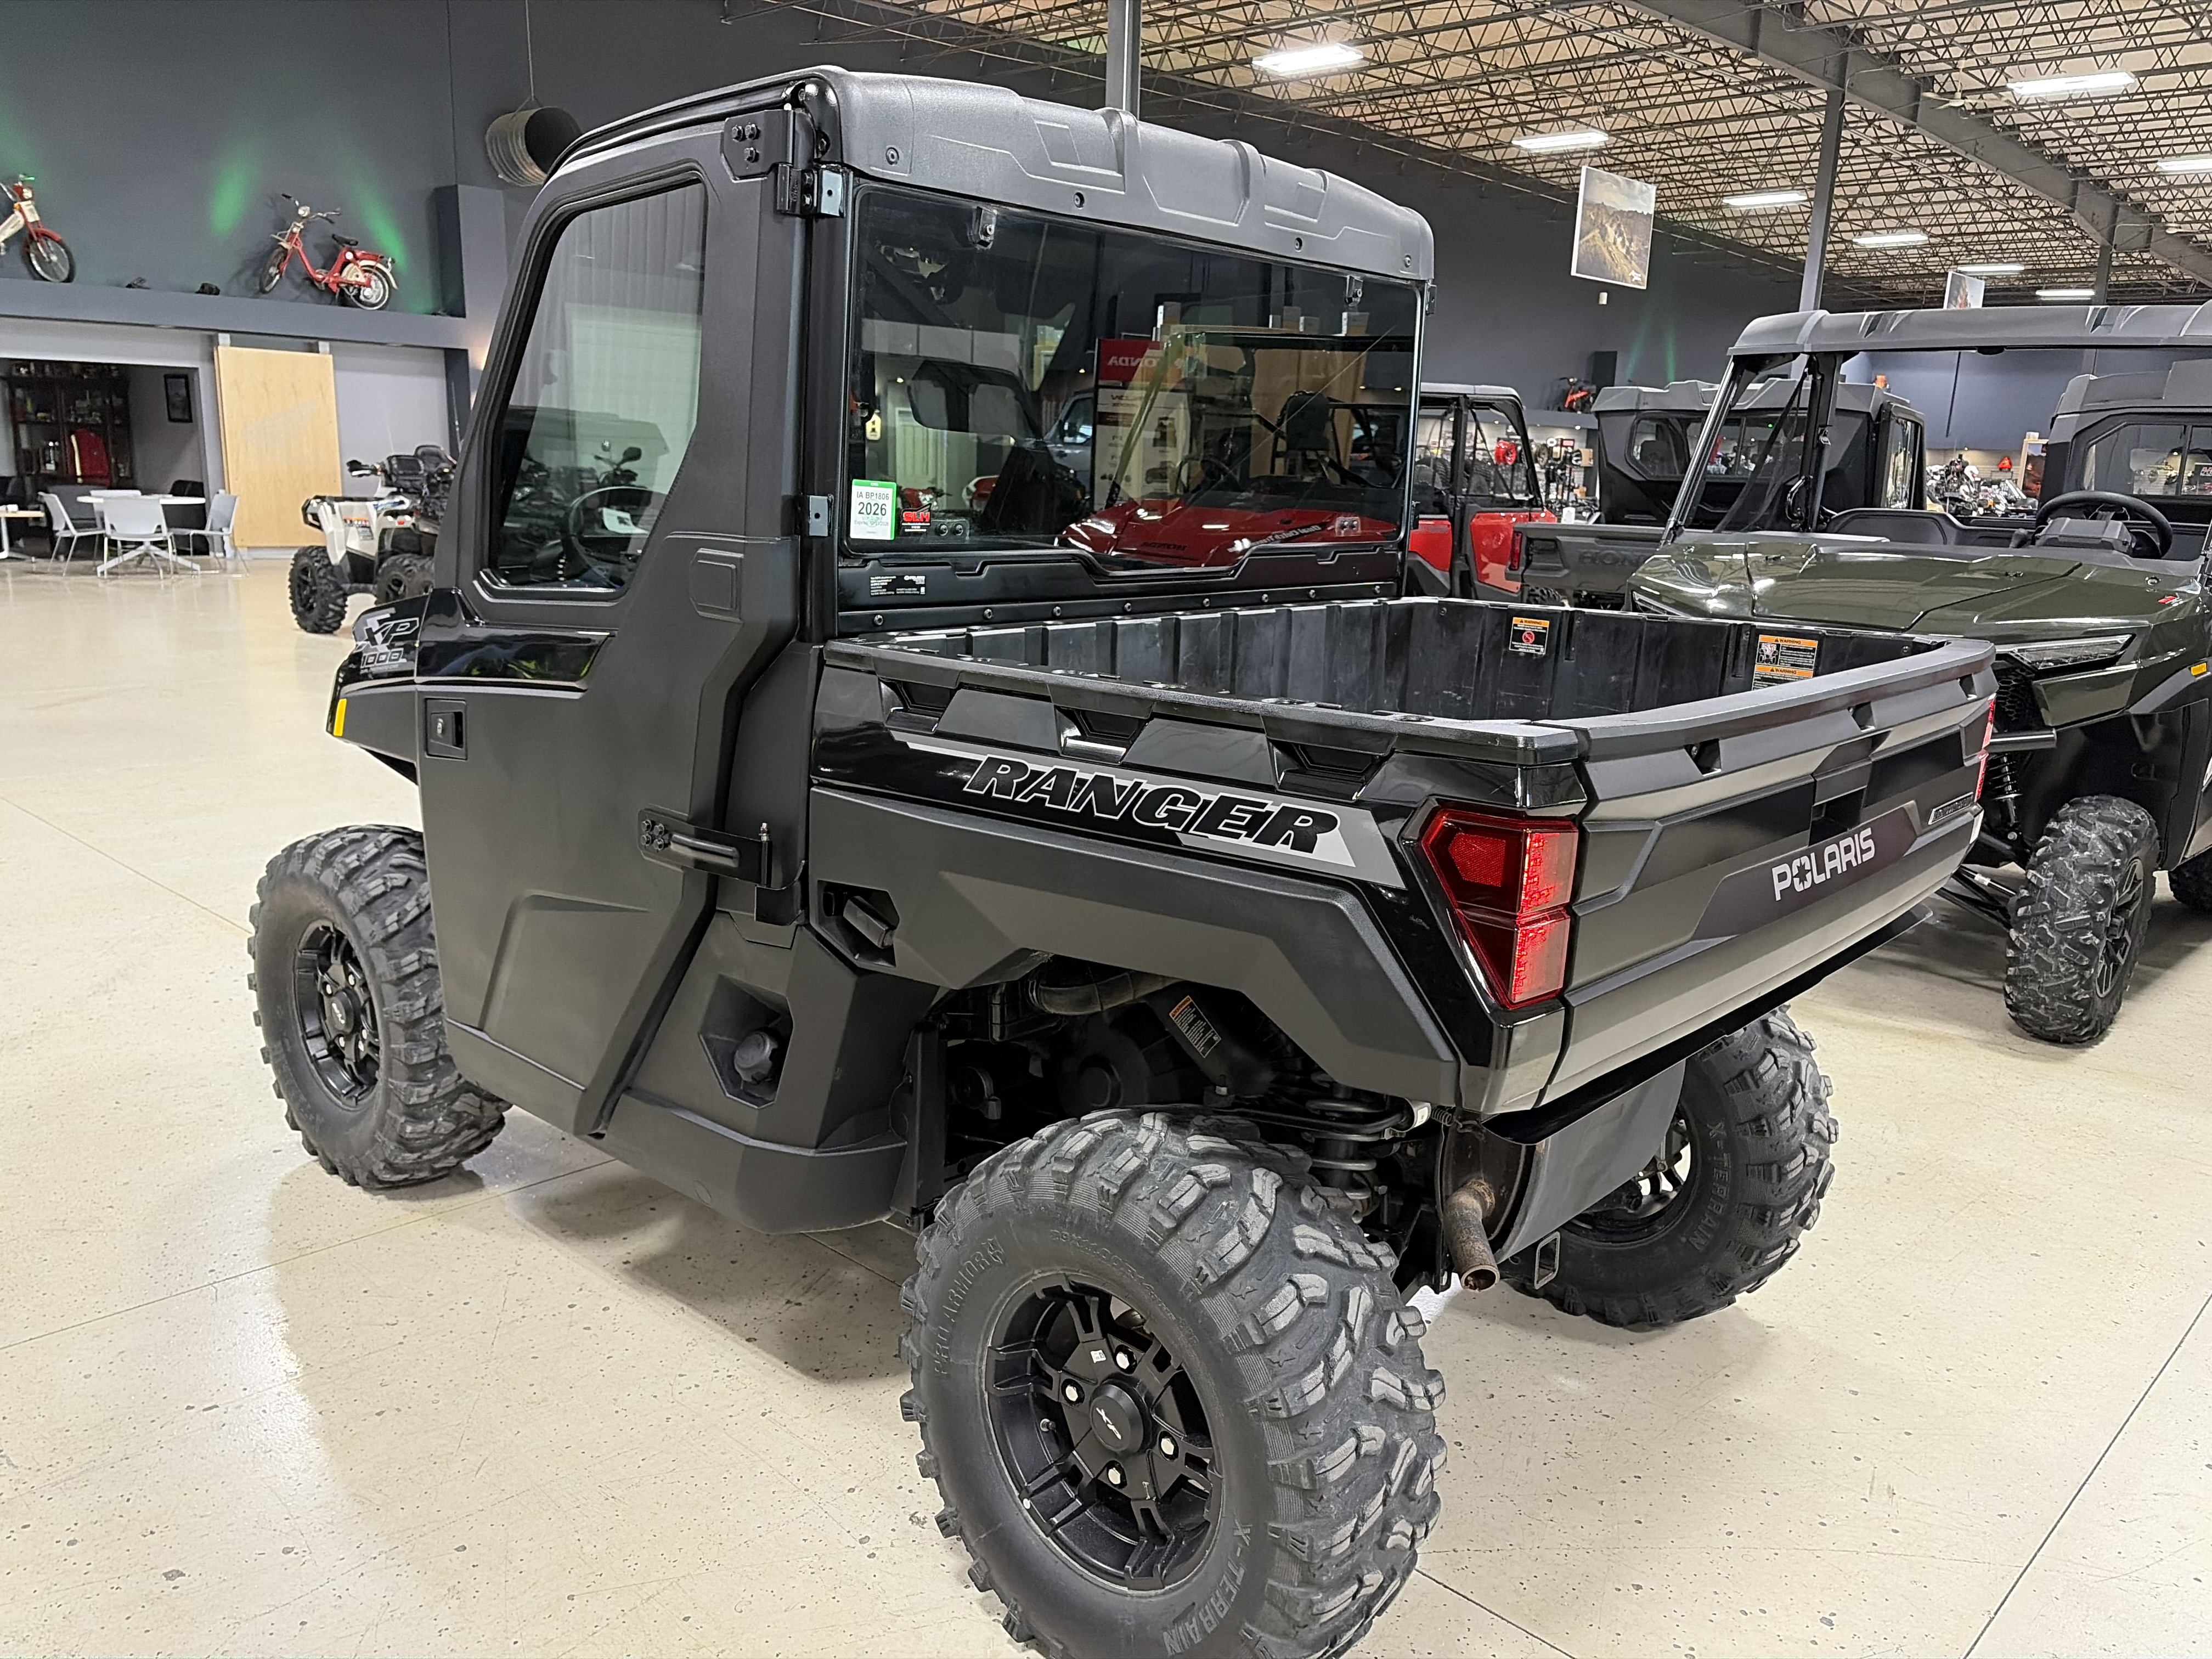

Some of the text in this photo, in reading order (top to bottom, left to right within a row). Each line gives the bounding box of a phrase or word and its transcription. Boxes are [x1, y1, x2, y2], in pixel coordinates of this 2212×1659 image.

[858, 501, 887, 516] 2026
[865, 492, 889, 500] BP1806
[352, 617, 420, 654] XP
[360, 648, 404, 669] 1000
[963, 755, 1340, 854] RANGER
[1771, 827, 1876, 901] POLARIS
[1689, 1120, 1731, 1252] X-TERRAIN
[1163, 1519, 1253, 1656] X-TERRAIN
